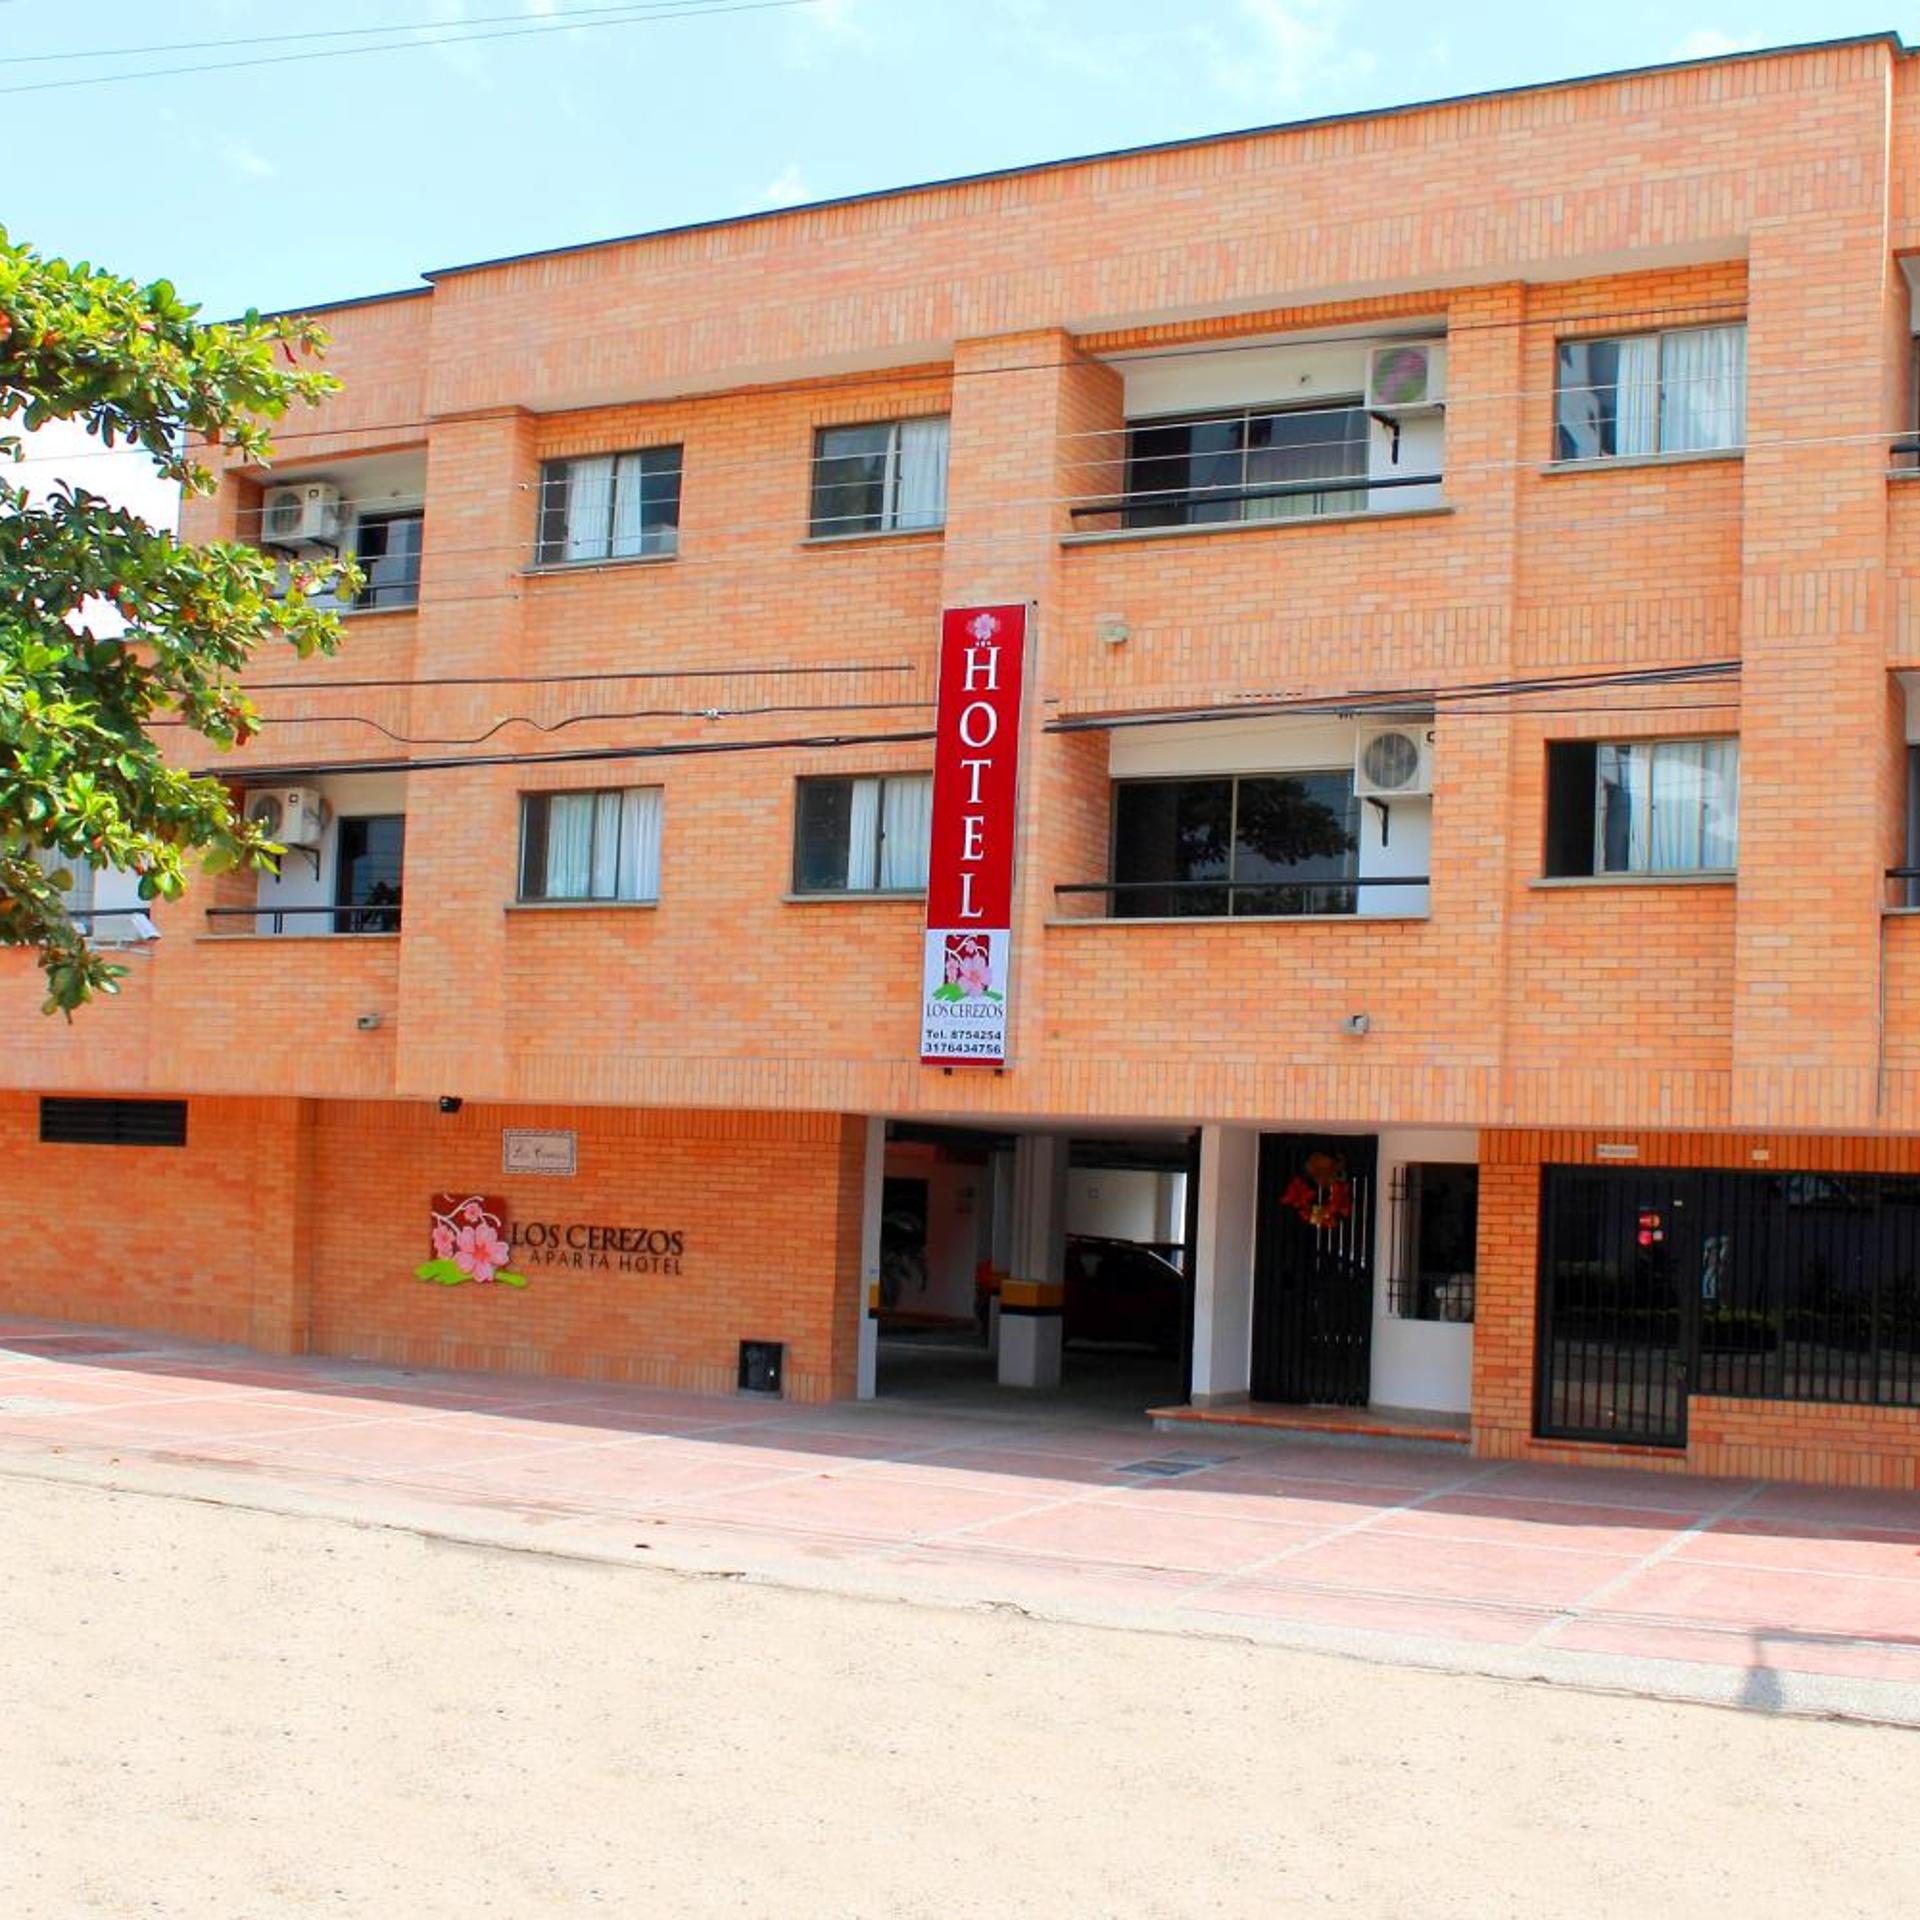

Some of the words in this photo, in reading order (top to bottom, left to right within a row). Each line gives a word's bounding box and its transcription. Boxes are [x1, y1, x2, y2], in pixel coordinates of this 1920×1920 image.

[959, 646, 1001, 918] HOTEL
[926, 1003, 948, 1018] LOS
[950, 1003, 1003, 1019] CEREZOS
[512, 1222, 560, 1248] LOS
[566, 1224, 684, 1257] CEREZOS
[529, 1250, 609, 1270] APARTA
[619, 1255, 682, 1276] HOTEL
